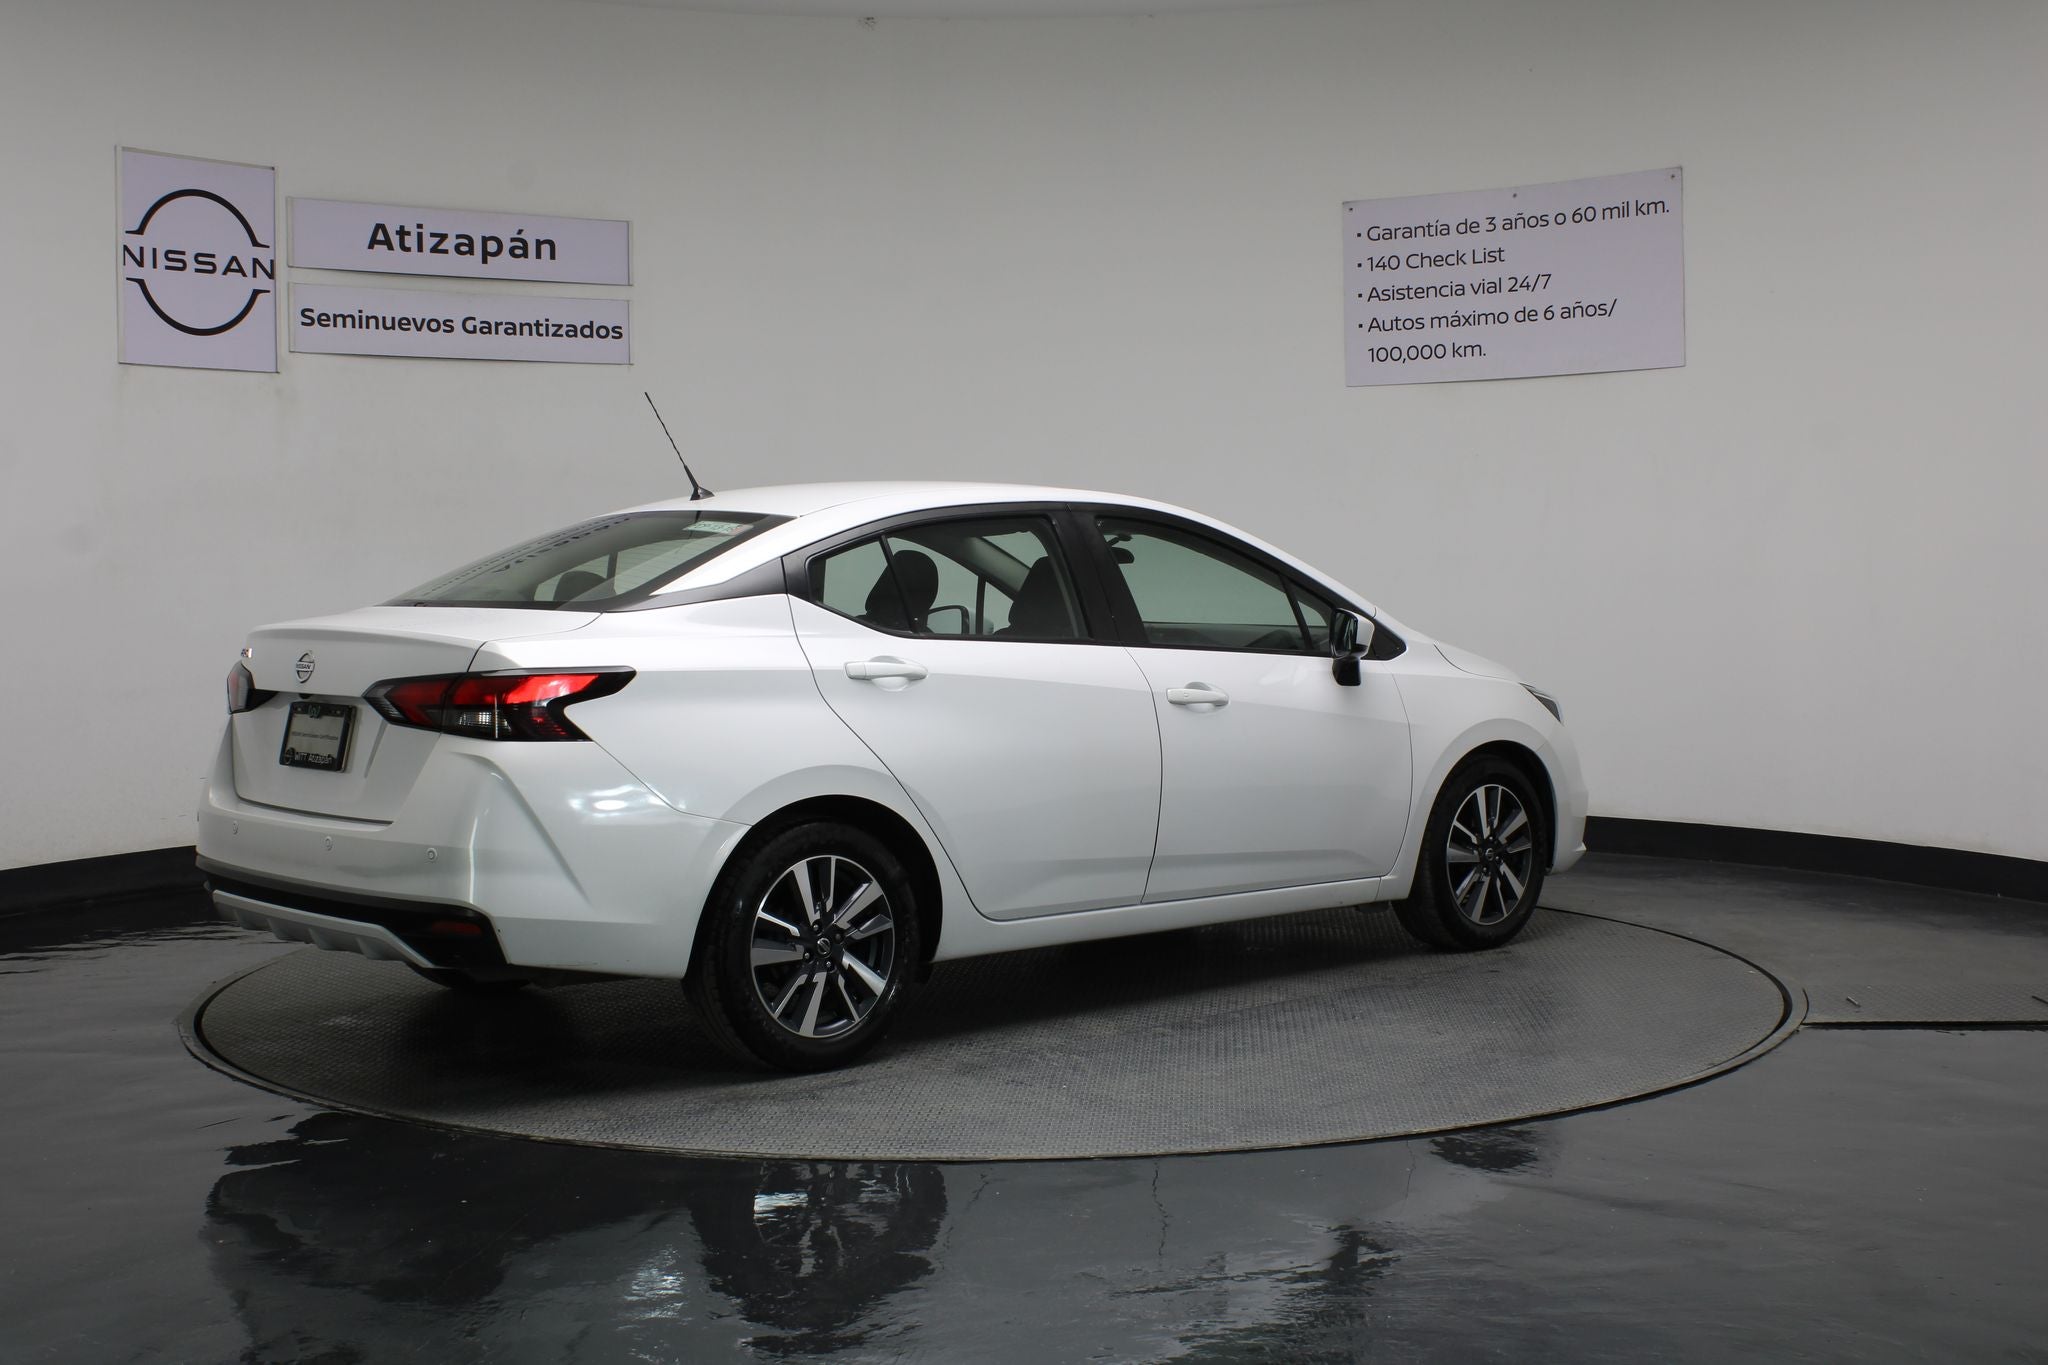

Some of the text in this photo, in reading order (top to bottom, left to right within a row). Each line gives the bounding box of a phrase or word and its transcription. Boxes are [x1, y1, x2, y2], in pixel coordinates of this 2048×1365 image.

[1367, 200, 1669, 241] Garantía de 3 años o 60 mil km.
[367, 222, 557, 264] Atizapán
[1367, 247, 1505, 271] 140 Check List
[122, 244, 275, 280] NISSAN
[1367, 274, 1552, 302] Asistencia vial 24/7
[301, 308, 623, 340] Seminuevos Garantizados
[1367, 298, 1617, 333] Autos máximo de 6 años/
[1368, 342, 1486, 364] 100,000 km.
